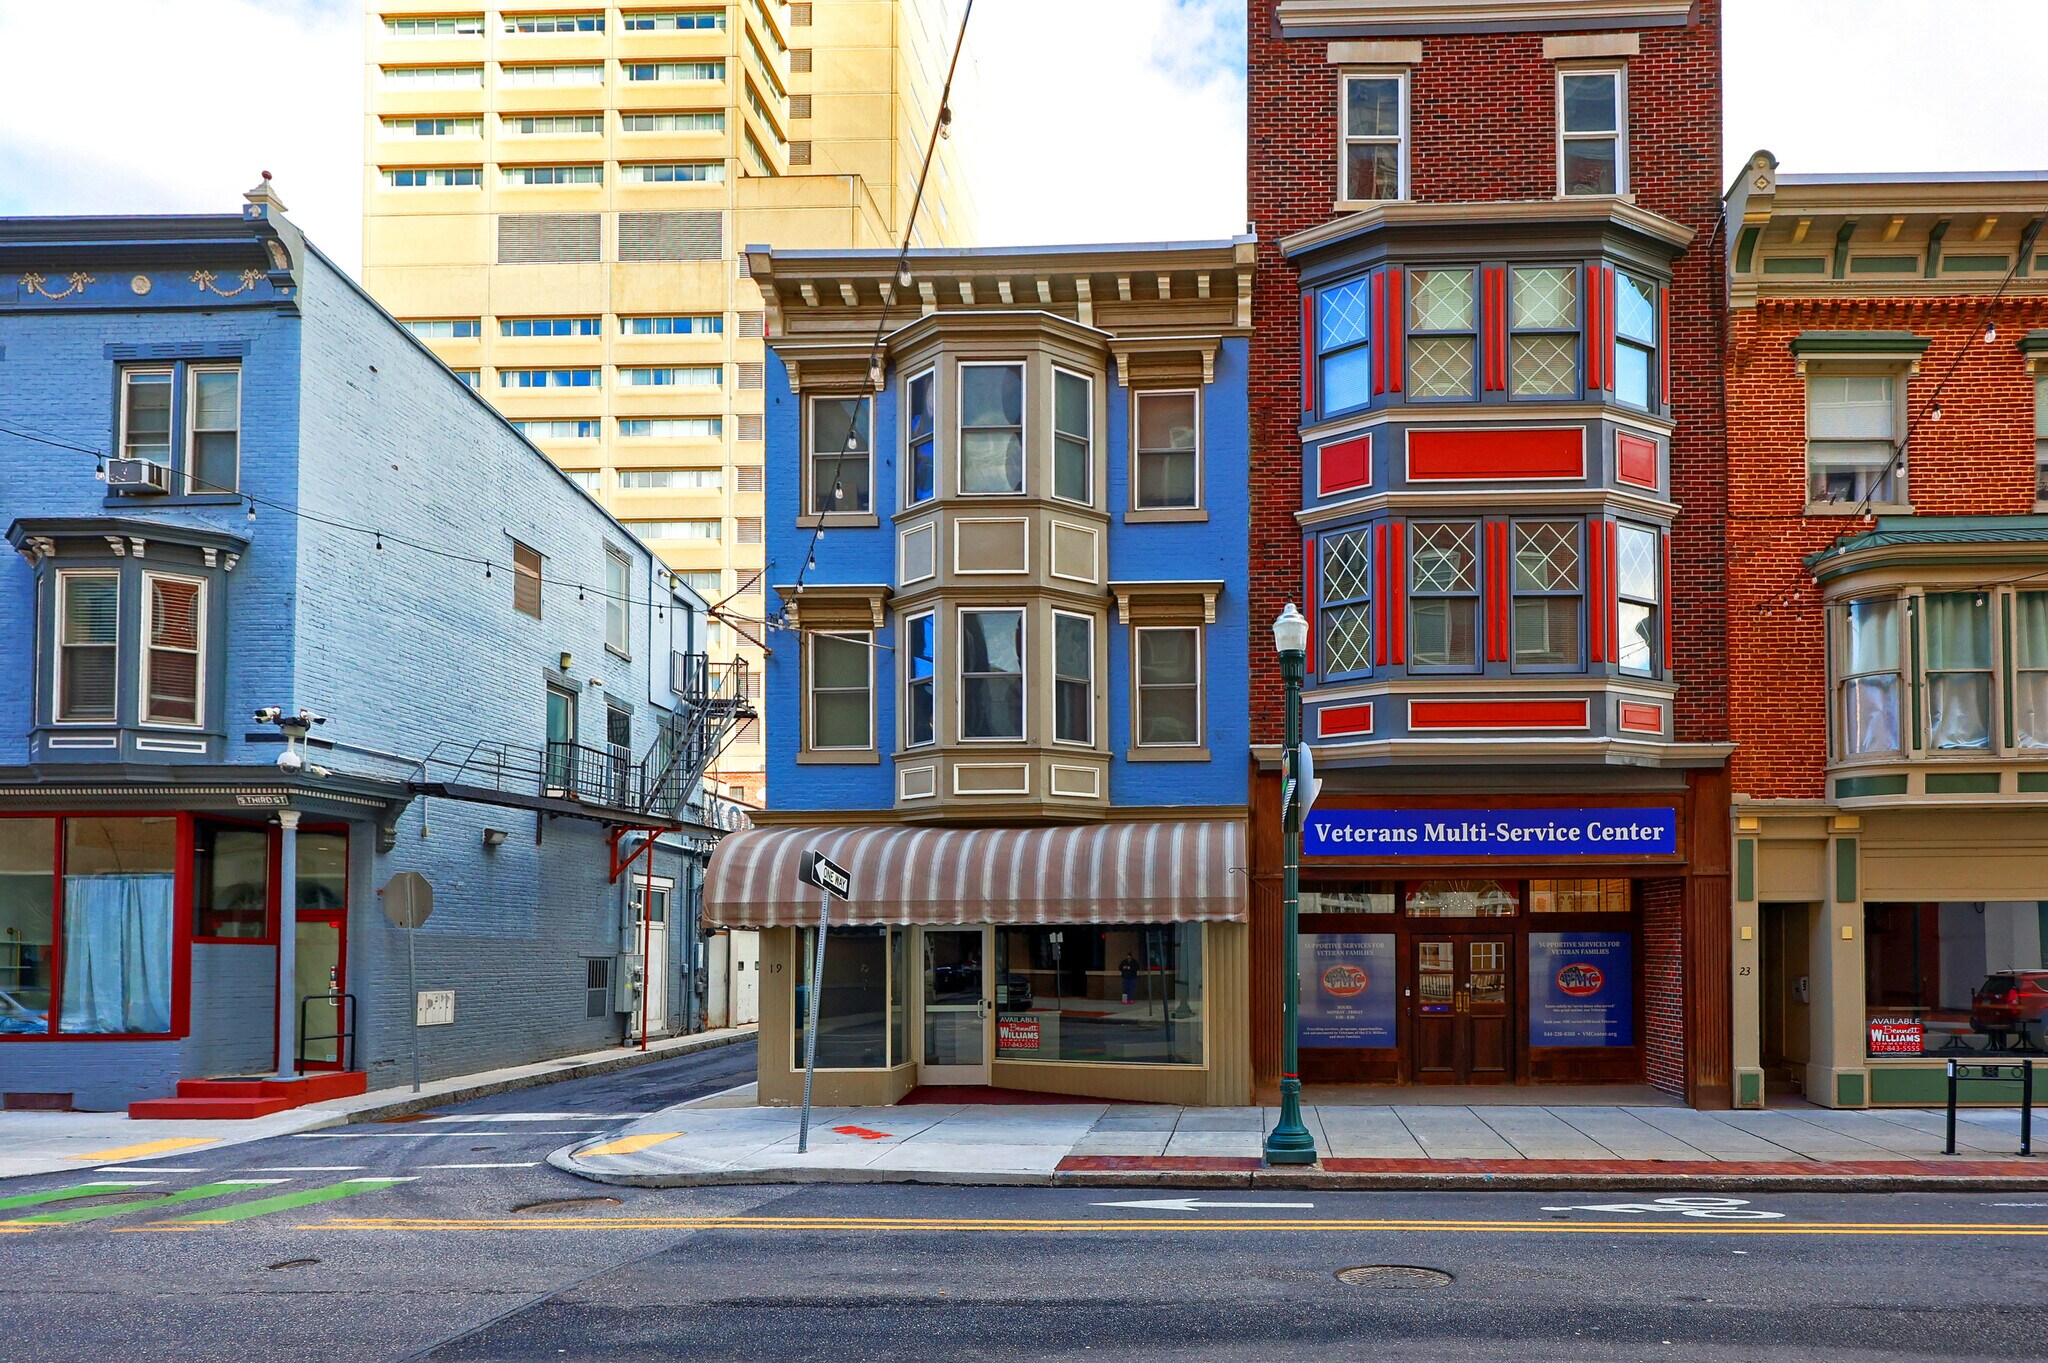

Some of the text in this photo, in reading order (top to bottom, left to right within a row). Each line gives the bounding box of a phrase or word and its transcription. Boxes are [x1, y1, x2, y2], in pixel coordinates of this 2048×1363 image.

[246, 796, 272, 804] THIRD
[273, 796, 285, 804] ST
[1314, 822, 1665, 843] Veterans Multi-Service Center
[823, 867, 847, 890] ONE WAY
[770, 963, 782, 974] 19
[1739, 966, 1751, 976] 23
[1328, 967, 1362, 988] VMC
[1563, 968, 1598, 987] VMC
[1000, 1027, 1039, 1039] WILLIAMS
[1009, 1024, 1038, 1032] Bennett
[1882, 1025, 1920, 1034] Bennett
[1871, 1029, 1921, 1042] WILLIAMS
